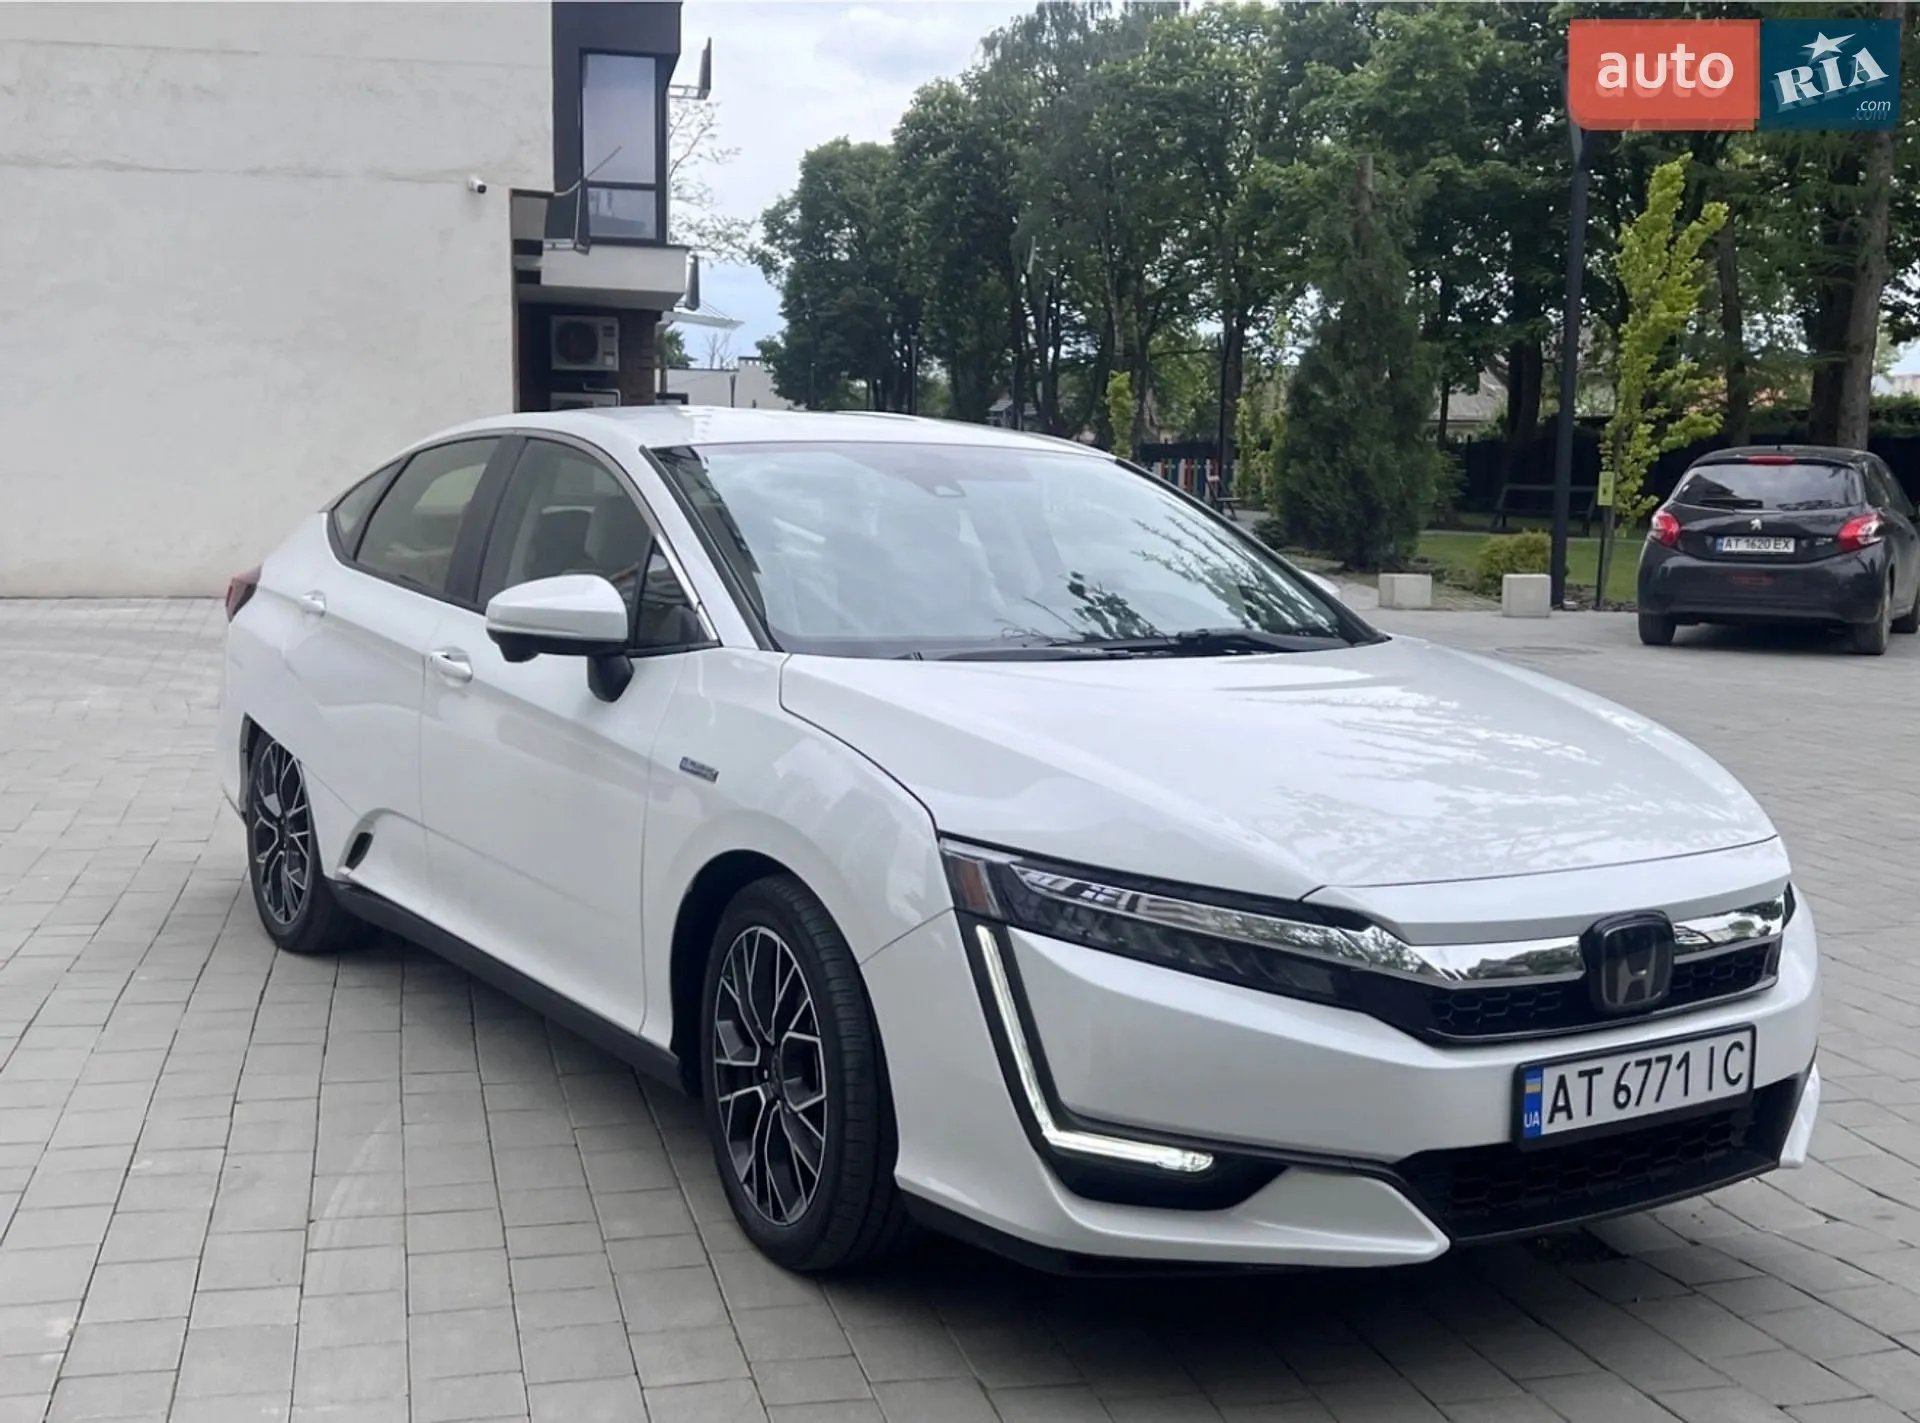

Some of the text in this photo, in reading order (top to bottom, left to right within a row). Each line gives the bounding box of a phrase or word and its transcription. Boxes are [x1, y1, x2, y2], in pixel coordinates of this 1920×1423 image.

[1725, 537, 1740, 549] AT
[1773, 537, 1790, 550] EX
[1547, 1041, 1745, 1124] AT 6771 IC
[1524, 1112, 1540, 1128] UA
